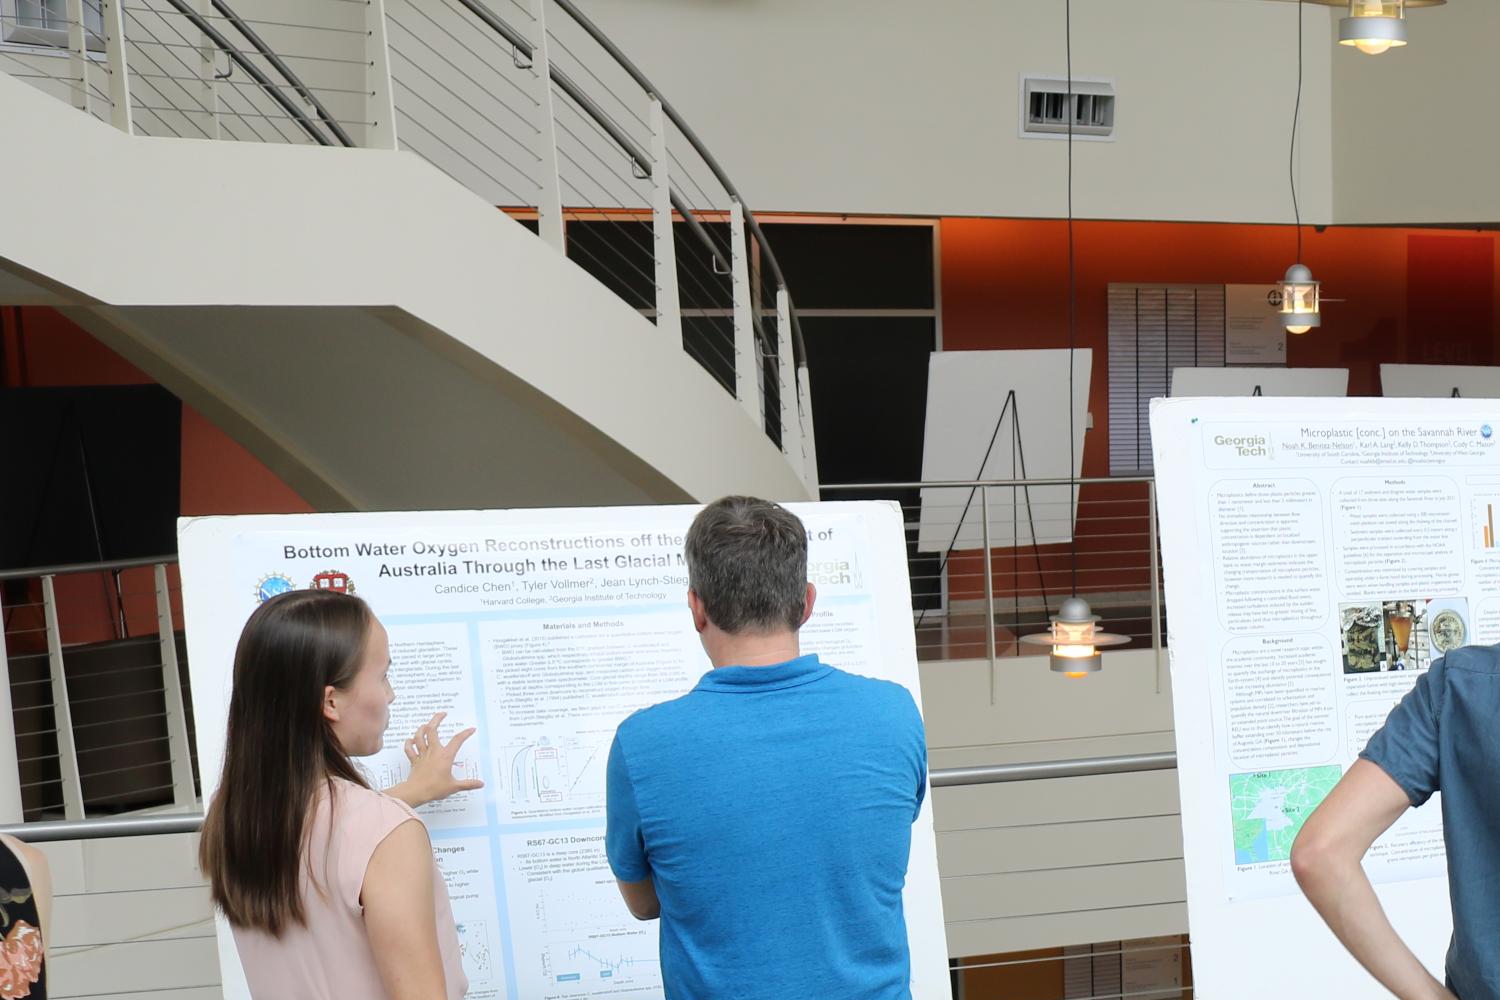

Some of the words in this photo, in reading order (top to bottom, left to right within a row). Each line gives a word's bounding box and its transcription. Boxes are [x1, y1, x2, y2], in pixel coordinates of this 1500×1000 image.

[1301, 427, 1353, 440] Microplastic
[1356, 427, 1385, 440] [conc.]
[1388, 429, 1400, 437] on
[1401, 427, 1416, 437] the
[1417, 426, 1455, 437] Savannah
[1456, 427, 1478, 437] River
[1215, 434, 1266, 447] Georgia
[1235, 446, 1267, 457] Tech
[818, 528, 833, 542] of
[284, 544, 350, 559] Bottom
[354, 543, 407, 558] Water
[412, 540, 480, 558] Oxygen
[485, 534, 626, 554] Reconstructions
[631, 532, 653, 547] off
[657, 533, 683, 547] the
[378, 561, 458, 579] Australia
[462, 558, 536, 577] Through
[541, 558, 569, 572] the
[573, 556, 610, 571] Last
[614, 553, 671, 569] Glacial
[807, 558, 850, 574] orgia
[434, 583, 479, 595] Candice
[521, 580, 548, 593] Tyler
[600, 577, 626, 588] Jean
[629, 574, 689, 588] Lynch-Stieg
[584, 593, 617, 602] Institute
[617, 592, 625, 601] of
[625, 591, 667, 602] Technology
[543, 623, 576, 631] Materials
[577, 622, 592, 630] and
[592, 620, 625, 629] Methods
[1262, 637, 1294, 645] Background
[1256, 771, 1268, 779] Site
[1284, 806, 1297, 814] Site
[527, 837, 569, 847] RS67-GC13
[432, 845, 465, 854] Changes
